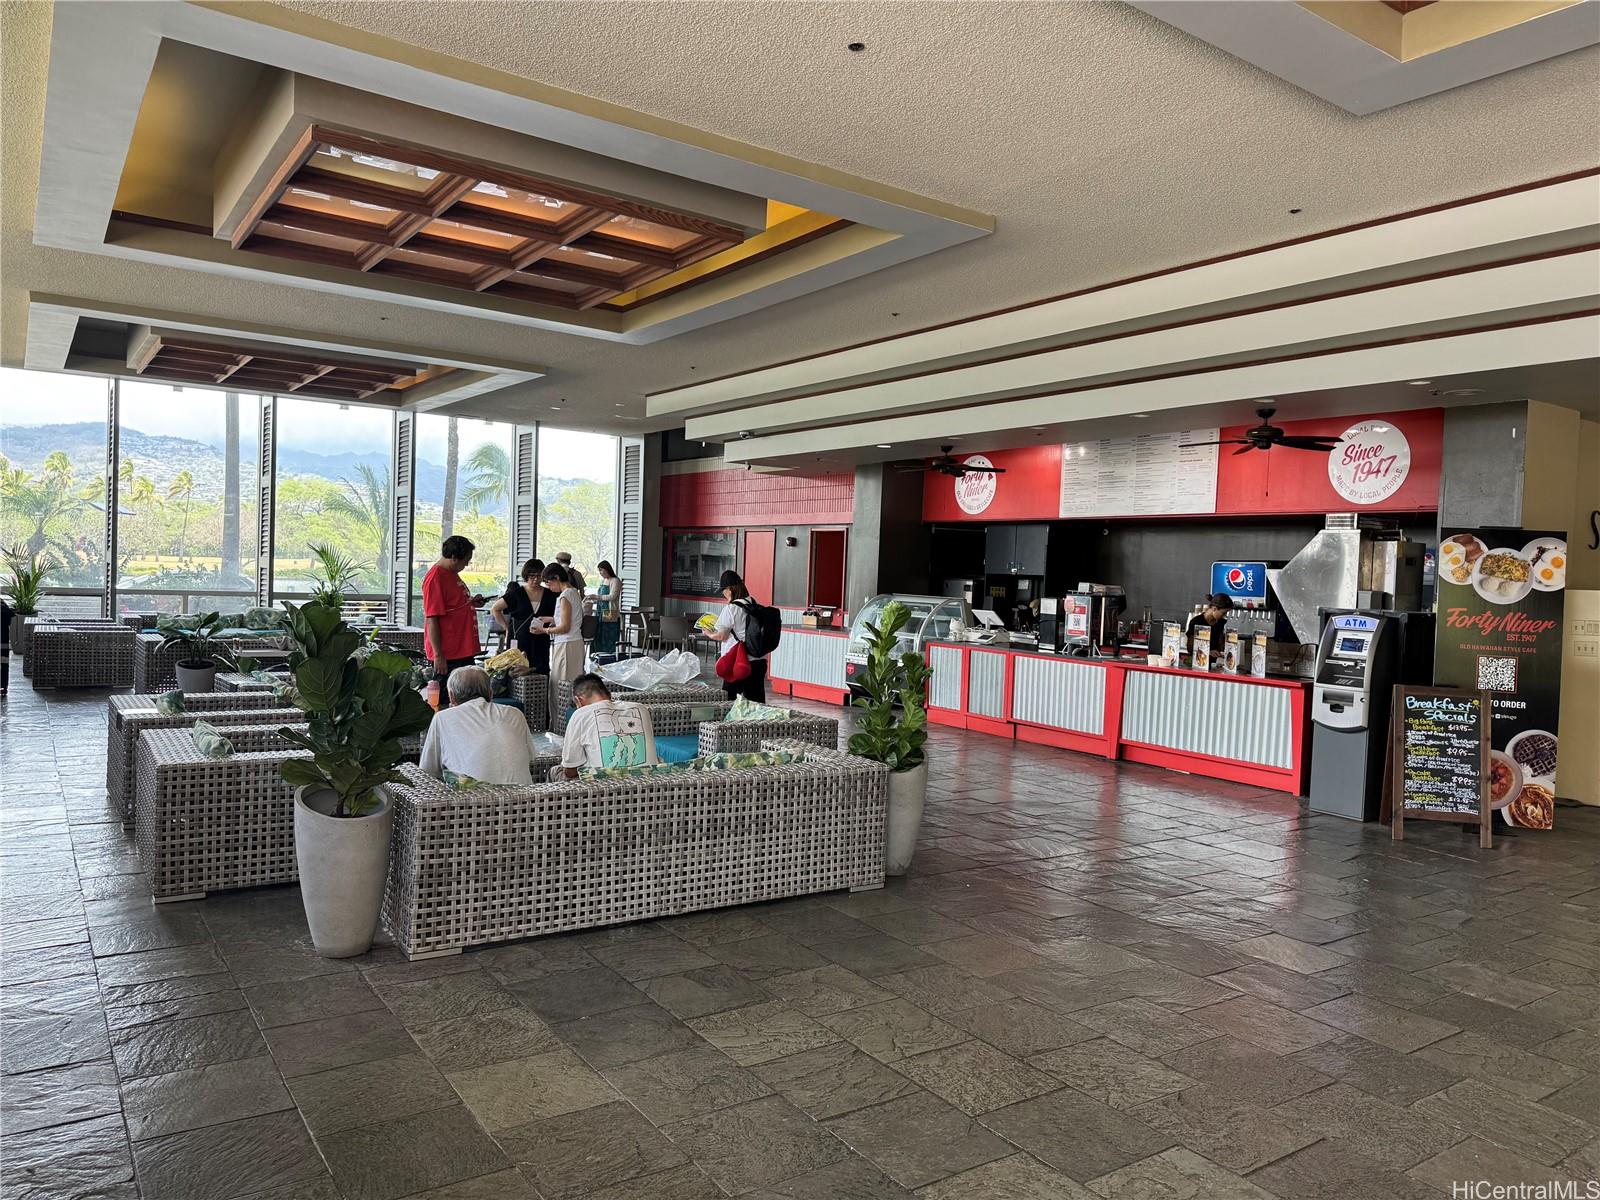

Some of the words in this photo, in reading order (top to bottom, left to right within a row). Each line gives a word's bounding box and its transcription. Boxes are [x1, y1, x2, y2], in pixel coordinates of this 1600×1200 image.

[1341, 443, 1385, 466] Since
[1353, 455, 1398, 484] 1947
[1359, 490, 1382, 499] LOCAL
[1381, 467, 1403, 493] PEOPLE
[1246, 569, 1254, 591] pepsi
[1344, 618, 1367, 628] ATM
[1446, 607, 1501, 636] Forty
[1498, 611, 1557, 633] Niner
[1506, 633, 1520, 642] EST.
[1521, 634, 1537, 643] 1947
[1471, 644, 1503, 652] HAWAIIAN
[1405, 695, 1473, 711] Breakfast
[1500, 700, 1527, 709] ORDER
